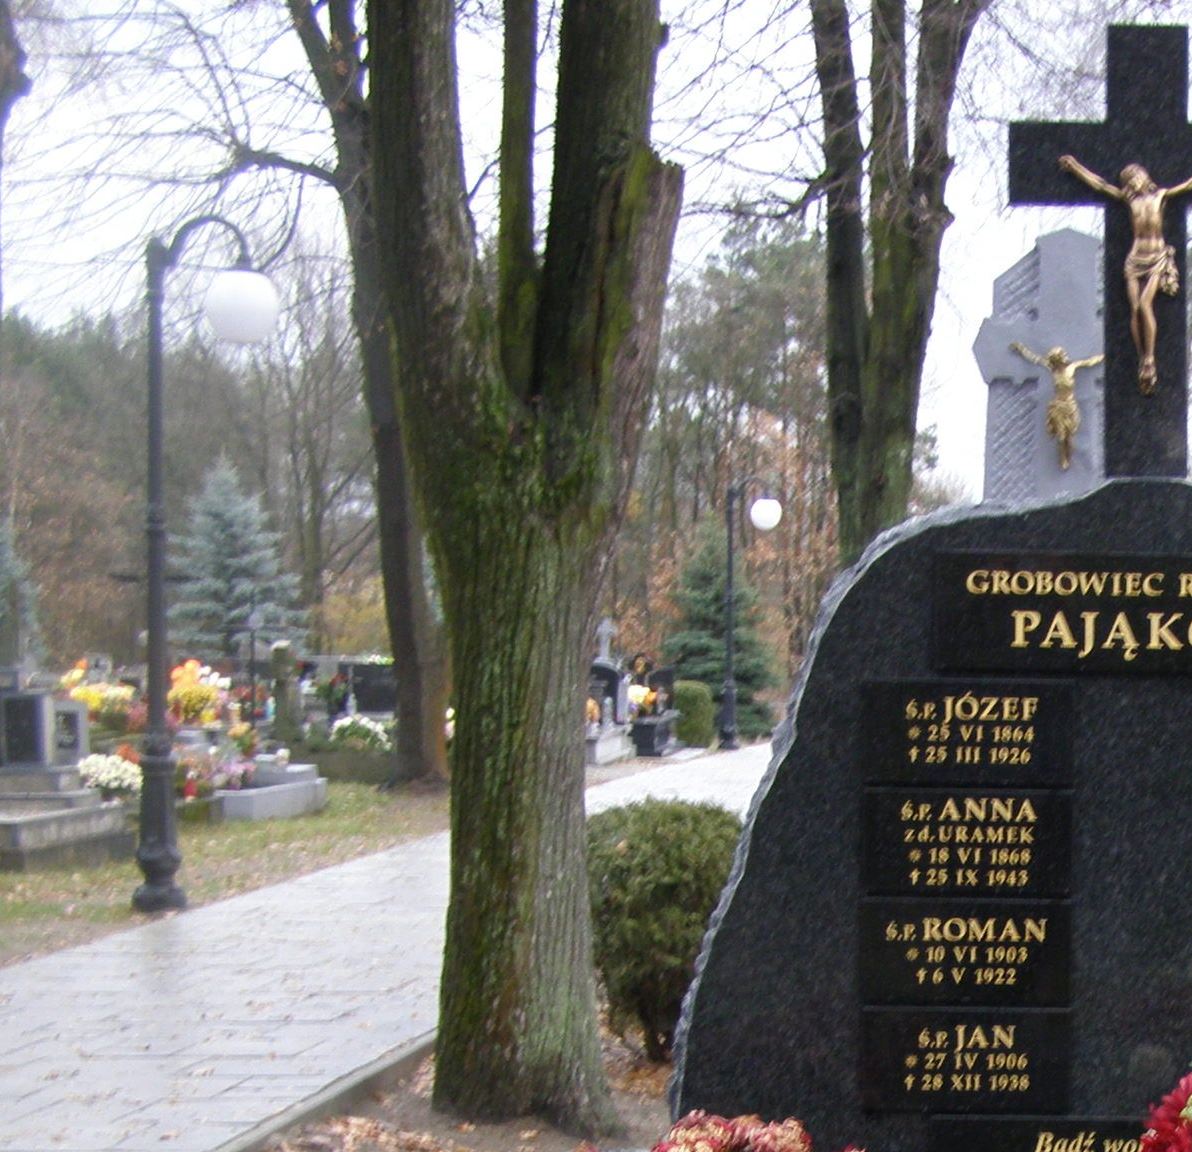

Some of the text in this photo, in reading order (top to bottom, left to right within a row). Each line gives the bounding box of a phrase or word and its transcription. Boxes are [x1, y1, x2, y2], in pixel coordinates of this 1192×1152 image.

[966, 569, 1165, 597] GROBOWIEC
[944, 690, 1039, 725] JÓZEF
[927, 724, 1036, 743] 25 VI 1864
[925, 746, 1032, 764] 25 III 1926
[938, 797, 1038, 823] ANNA
[957, 847, 982, 865] VI
[925, 868, 1029, 887] 25 IX 1943
[922, 917, 1048, 943] ROMAN
[926, 945, 1028, 964] 10 VI 1903
[932, 967, 1017, 986] 6 V 1922
[953, 1024, 1016, 1052] JAN
[924, 1052, 1028, 1070] 27 IV 1906
[950, 1073, 982, 1091] XII
